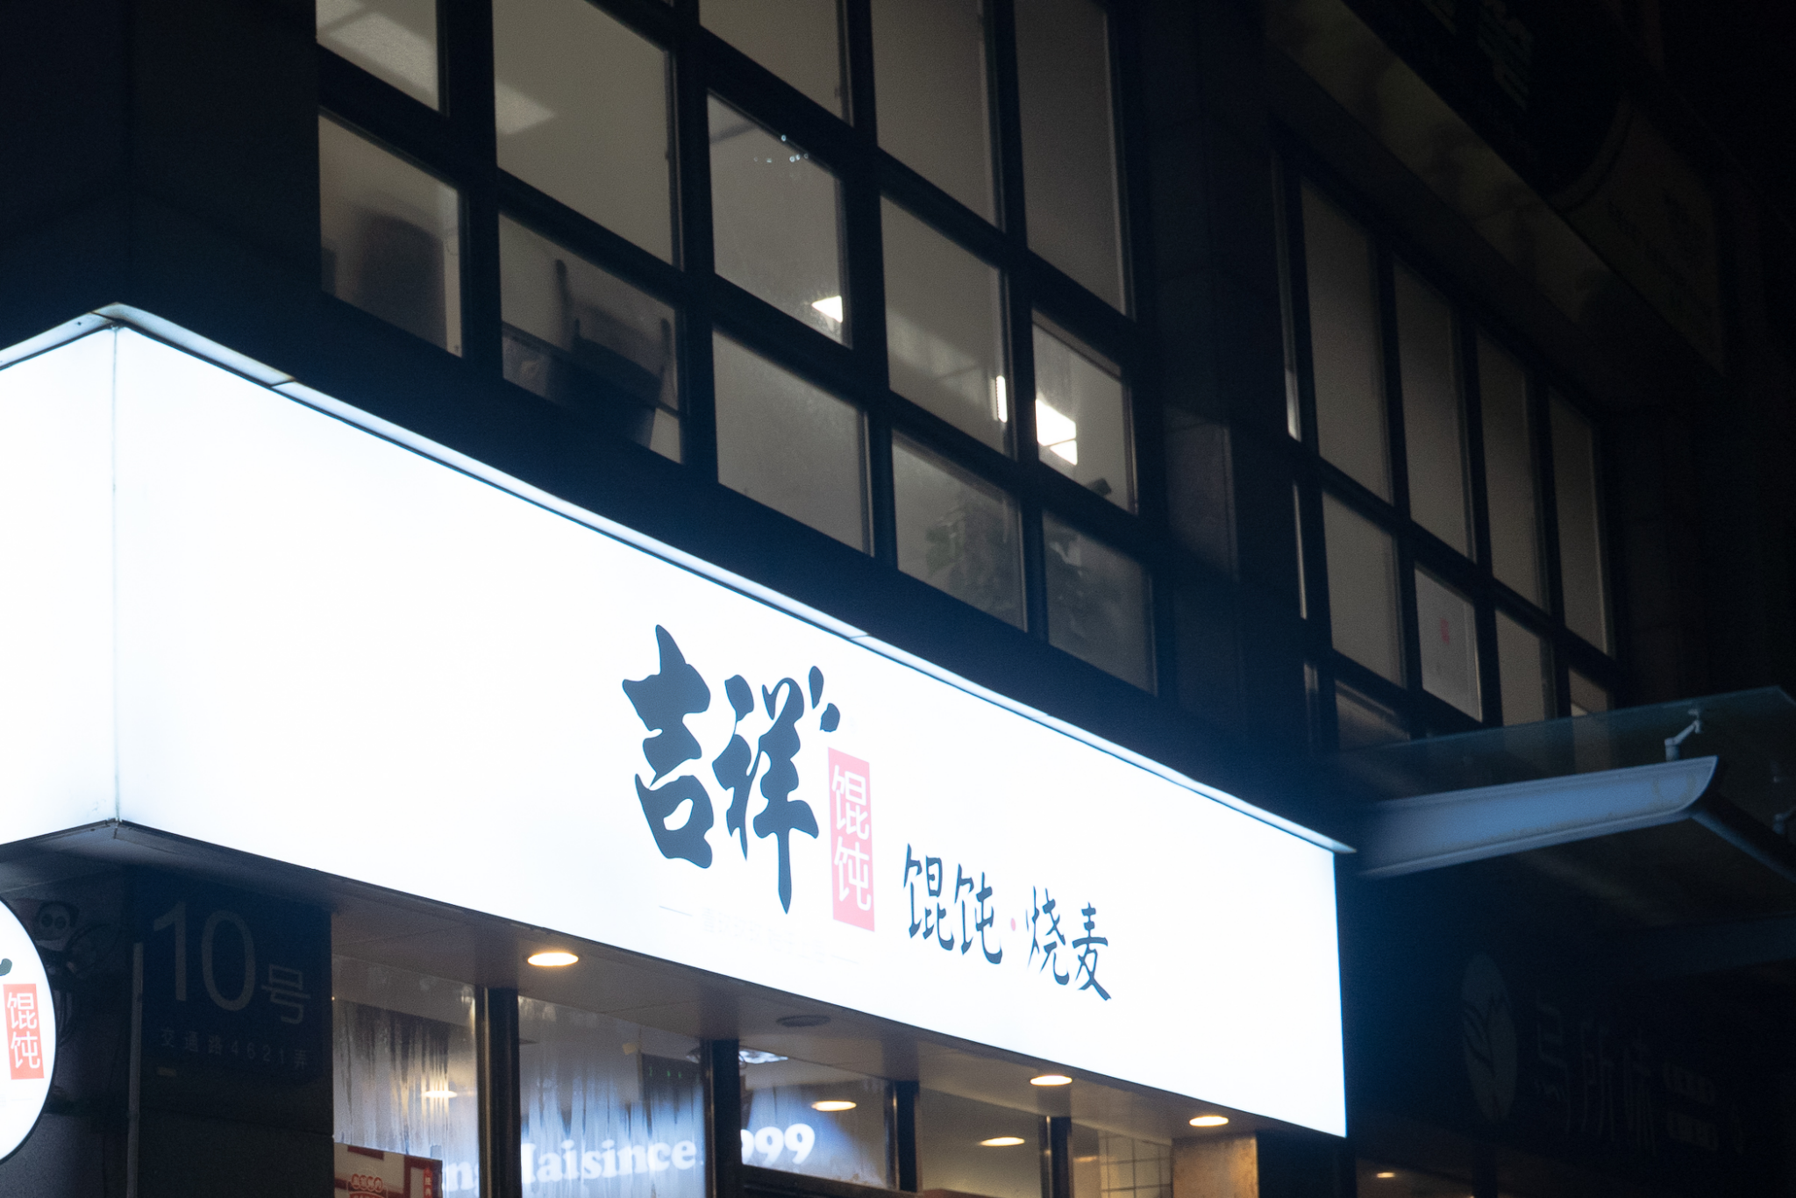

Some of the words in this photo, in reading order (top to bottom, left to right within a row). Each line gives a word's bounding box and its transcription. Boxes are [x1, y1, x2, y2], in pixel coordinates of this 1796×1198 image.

[622, 624, 841, 914] 吉祥
[830, 763, 873, 912] 馄饨
[7, 991, 41, 1069] 馄饨
